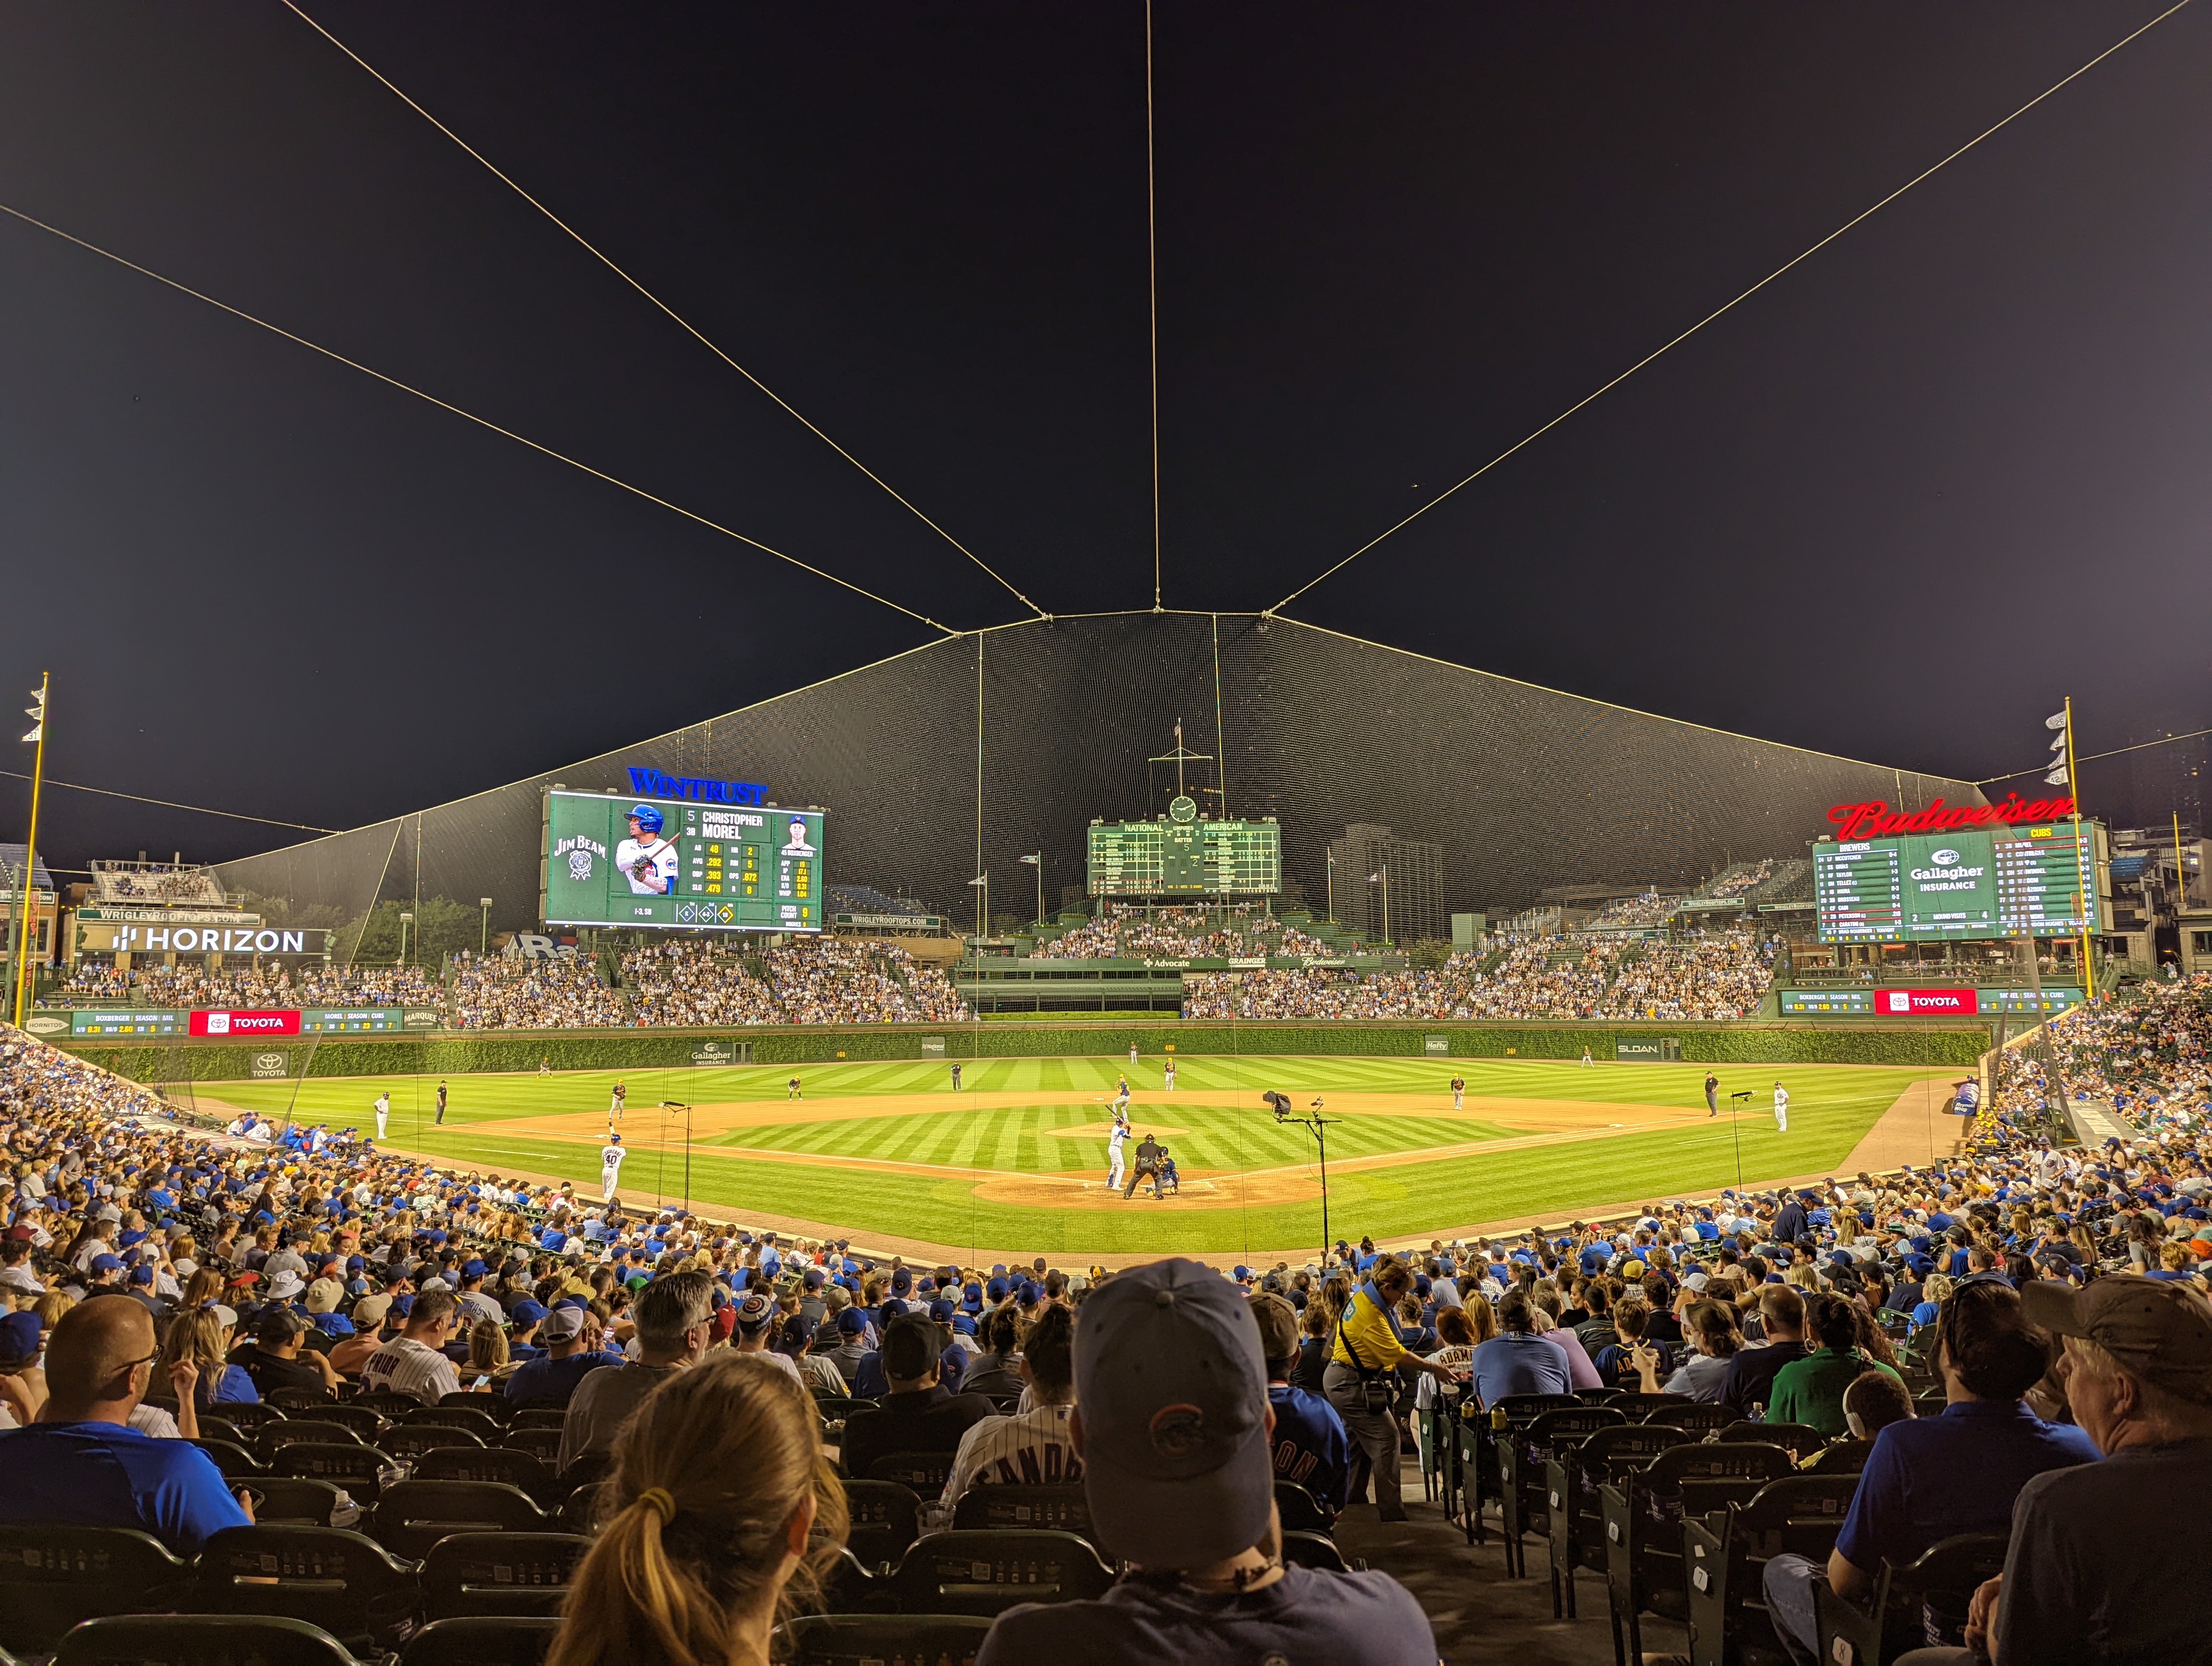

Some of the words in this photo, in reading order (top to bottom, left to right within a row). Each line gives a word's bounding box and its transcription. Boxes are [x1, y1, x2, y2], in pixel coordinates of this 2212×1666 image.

[628, 767, 768, 805] WINTRUST
[688, 810, 695, 821] 5
[703, 811, 763, 826] CHRISTOPHER
[1828, 792, 2076, 840] Budweiser
[686, 827, 696, 836] 3B
[702, 824, 742, 840] MOREL
[2030, 828, 2052, 837] CUBS
[554, 838, 575, 856] JIM
[577, 835, 606, 858] BEAM
[710, 845, 719, 854] 48
[748, 847, 753, 856] 2
[1840, 843, 1870, 852] BREWERS
[706, 858, 722, 867] .292
[748, 860, 753, 868] 5
[706, 871, 721, 880] .393
[742, 873, 757, 882] .872
[1911, 866, 1984, 880] Gallagher
[706, 884, 721, 893] .479
[747, 886, 752, 894] 8
[1920, 881, 1976, 892] INSURANCE
[100, 910, 240, 922] WRIGLEYROOFTOPS.COM
[802, 907, 808, 918] 9
[851, 915, 927, 925] WRIGLEYROOFTOPS.COM
[146, 928, 304, 952] HORIZON
[1302, 957, 1346, 966] Budweiser
[1913, 997, 1959, 1007] TOYOTA
[404, 1013, 438, 1022] MARQUEE
[234, 1018, 284, 1028] TOYOTA
[691, 1052, 731, 1060] Gallagher
[606, 1155, 617, 1164] 40
[367, 1353, 400, 1378] PRIOR
[1840, 1643, 1846, 1660] 8
